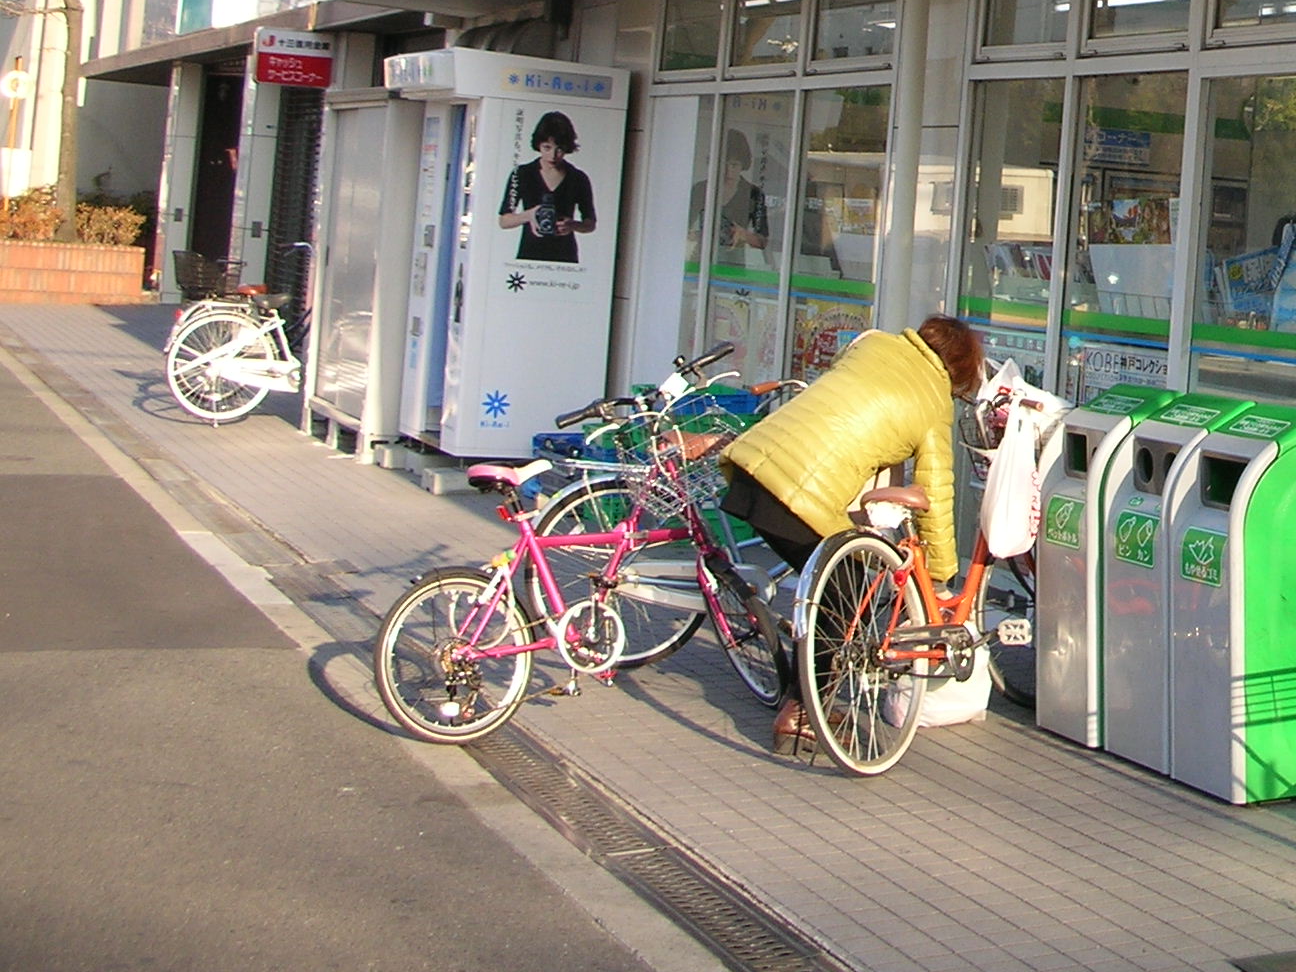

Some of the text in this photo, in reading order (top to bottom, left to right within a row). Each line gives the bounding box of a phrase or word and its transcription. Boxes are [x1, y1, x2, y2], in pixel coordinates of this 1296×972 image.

[1086, 346, 1119, 375] KOBE
[1118, 544, 1150, 562] ビン カン
